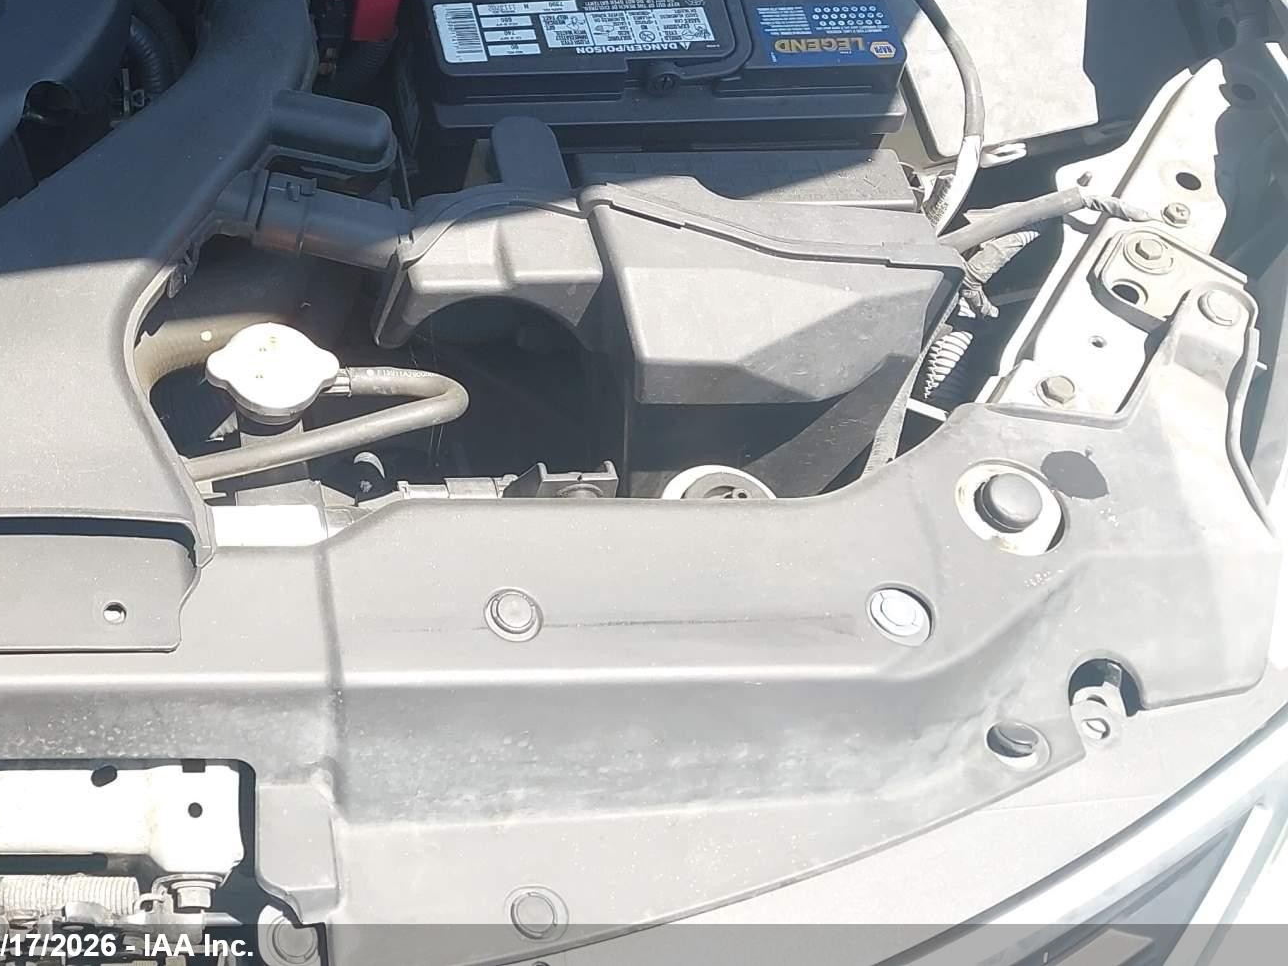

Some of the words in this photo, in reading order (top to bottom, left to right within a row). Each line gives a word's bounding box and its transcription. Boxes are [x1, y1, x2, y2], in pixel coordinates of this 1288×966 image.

[576, 42, 678, 53] DANGER/POISON
[774, 38, 864, 53] LEGEND
[874, 46, 893, 54] NAPA
